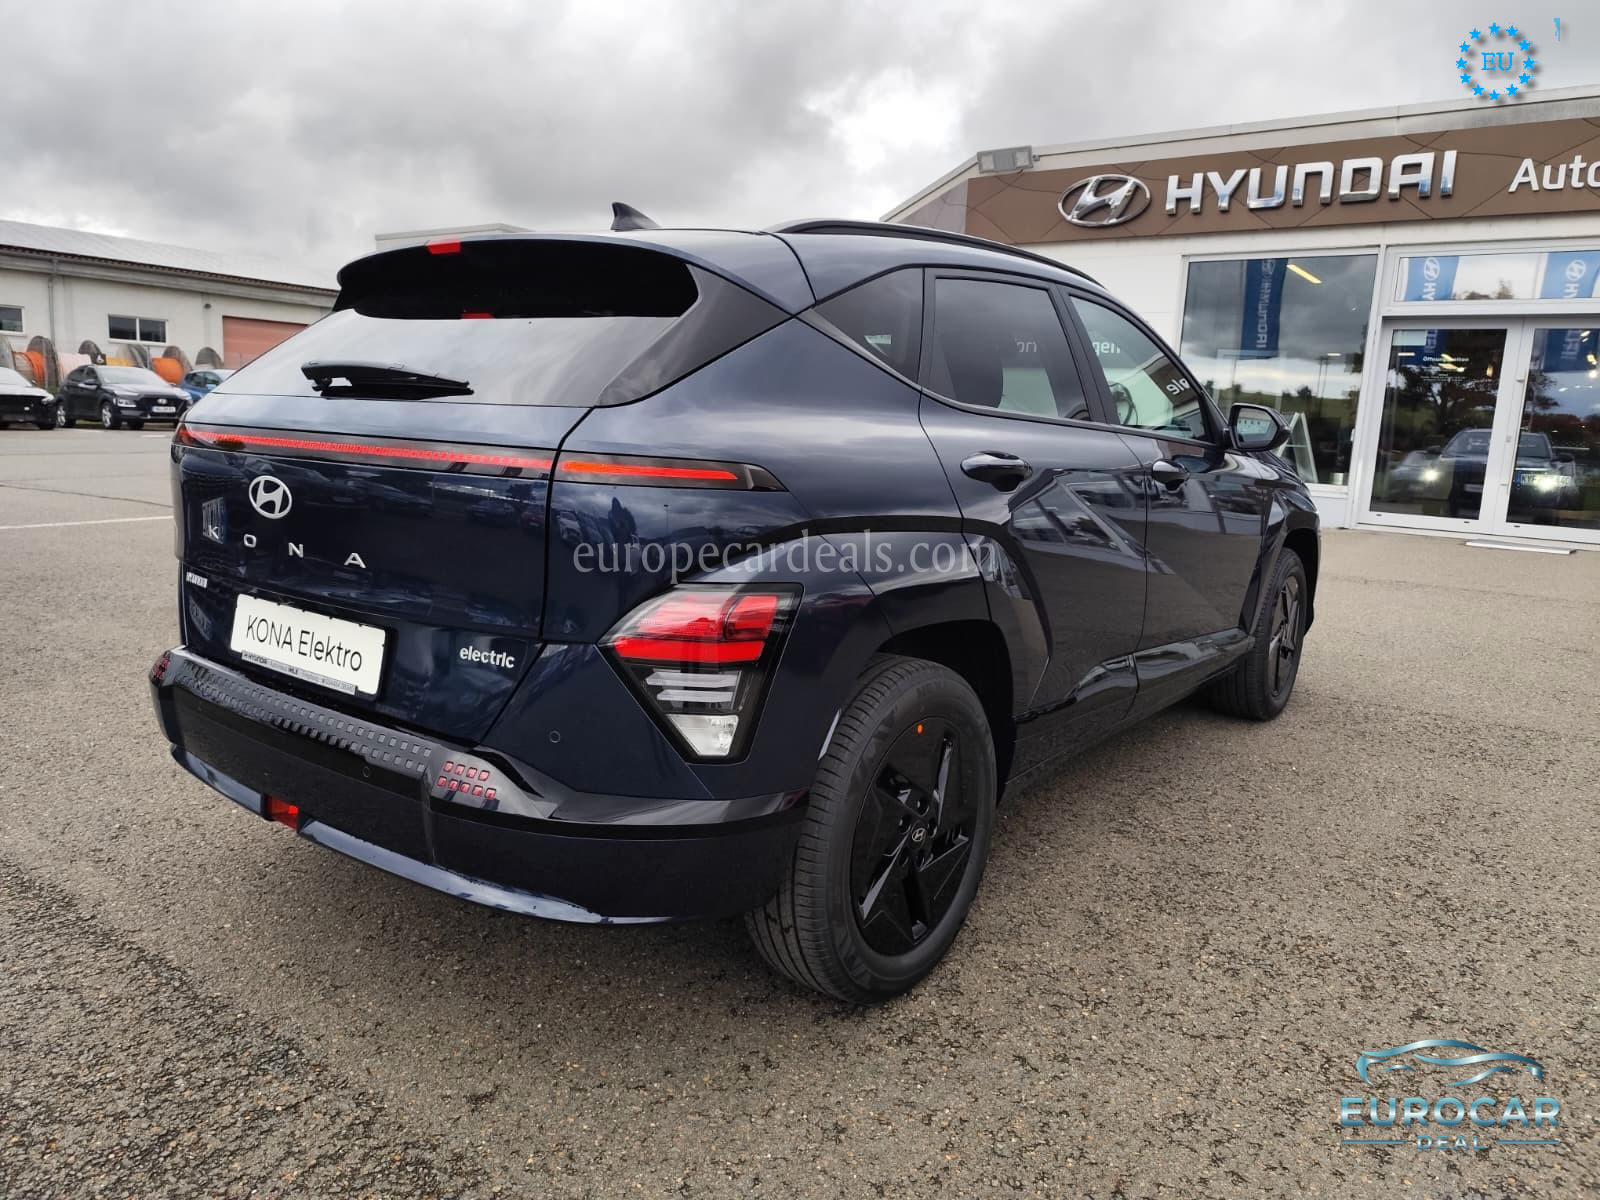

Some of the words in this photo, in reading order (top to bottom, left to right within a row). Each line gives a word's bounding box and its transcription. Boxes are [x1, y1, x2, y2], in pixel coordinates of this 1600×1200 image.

[1165, 150, 1457, 216] HYUNDAI
[1508, 154, 1600, 193] Auto
[246, 615, 293, 652] KONA
[298, 630, 362, 671] Elektro
[459, 646, 515, 669] electric
